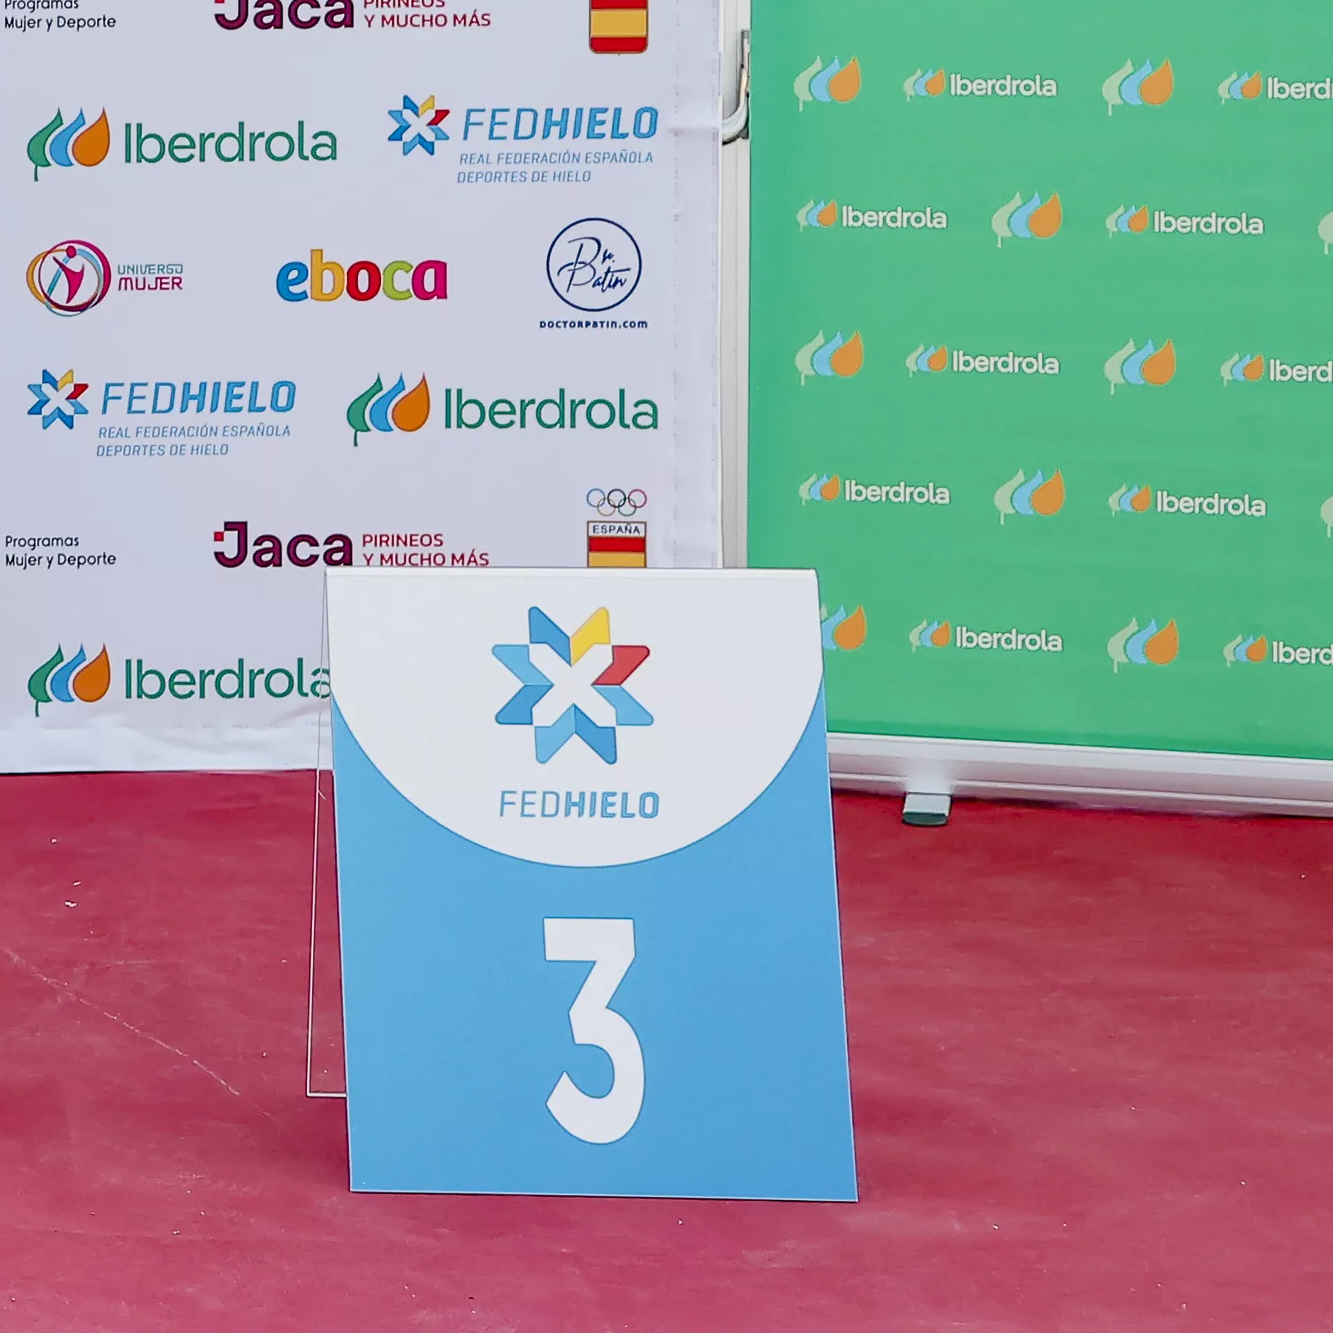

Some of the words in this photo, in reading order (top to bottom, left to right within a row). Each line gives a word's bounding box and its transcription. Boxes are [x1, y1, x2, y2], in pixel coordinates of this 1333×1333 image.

[364, 15, 375, 27] Y
[382, 14, 447, 27] MUCHO
[453, 9, 490, 26] MÁS
[276, 249, 447, 302] eboca
[955, 626, 1063, 651] Iberdrola
[500, 791, 659, 818] FEDHIELO
[543, 917, 645, 1145] 3
